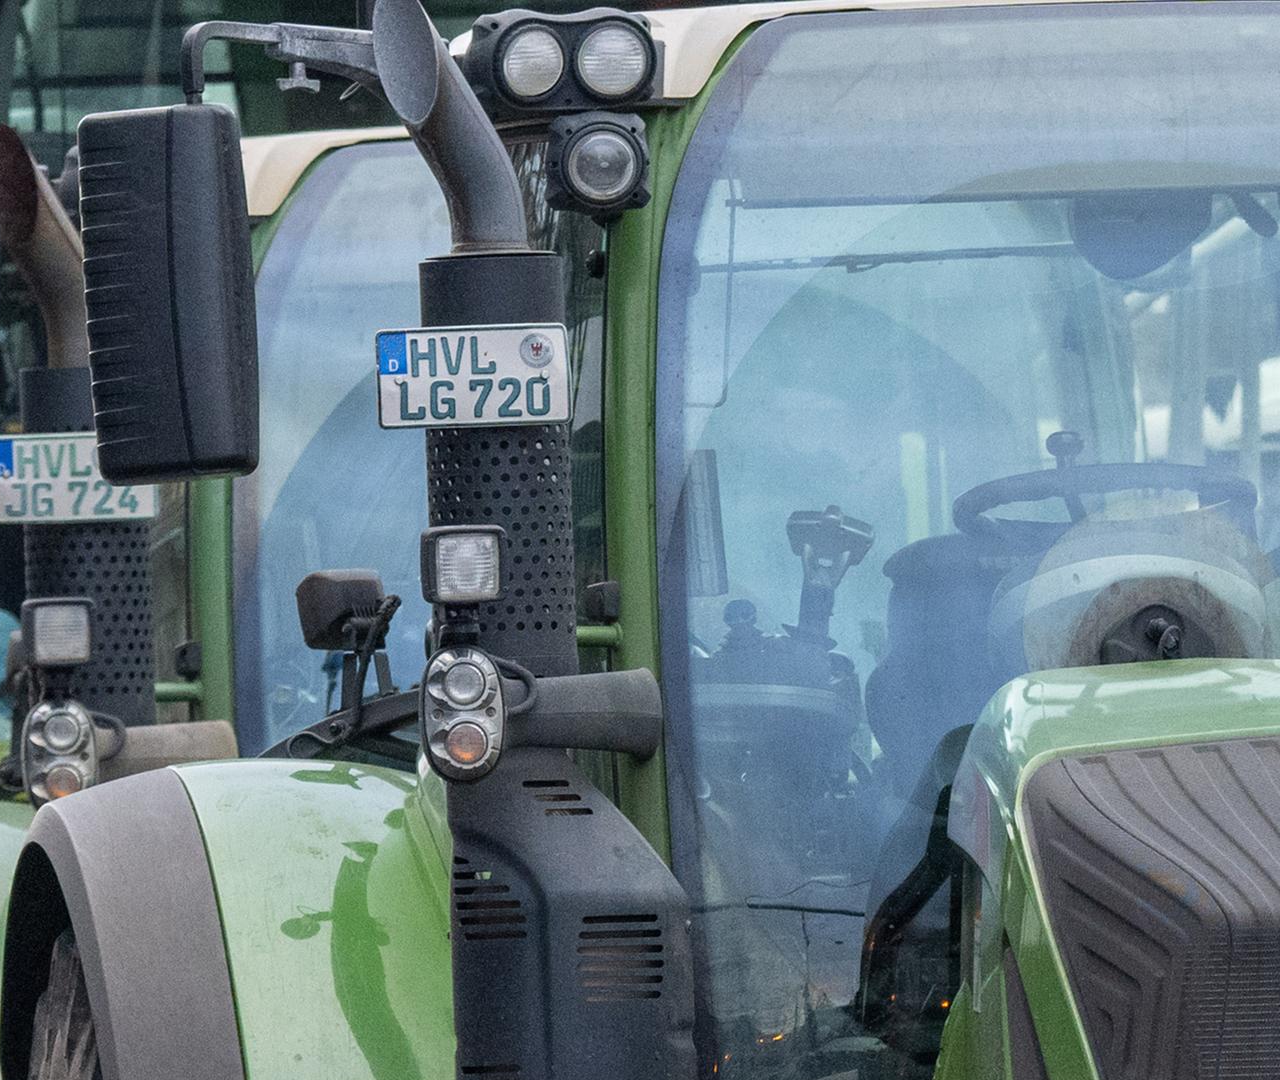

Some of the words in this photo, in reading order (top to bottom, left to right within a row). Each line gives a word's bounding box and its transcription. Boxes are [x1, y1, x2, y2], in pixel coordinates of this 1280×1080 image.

[387, 359, 399, 372] D
[409, 335, 497, 377] HVL
[400, 379, 456, 420] LG
[469, 376, 551, 419] 720
[16, 443, 92, 479] HVL
[5, 481, 54, 517] JG
[67, 480, 138, 516] 724
